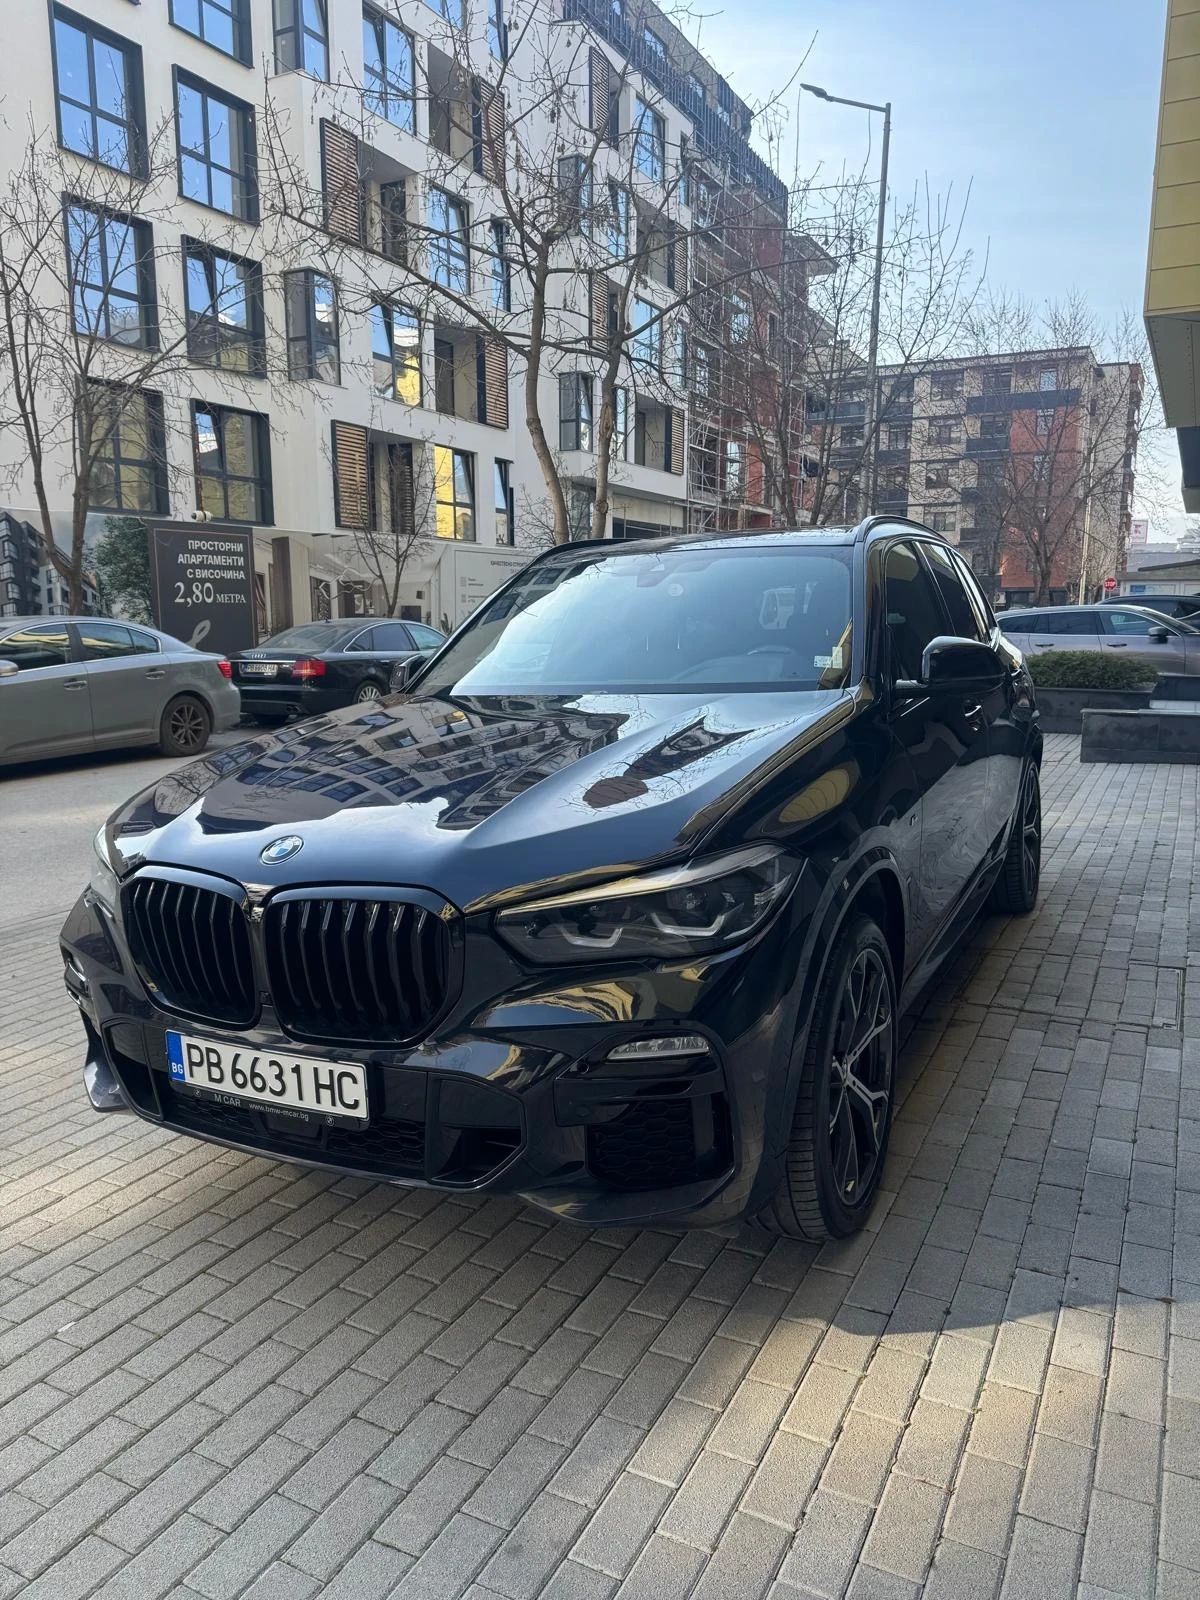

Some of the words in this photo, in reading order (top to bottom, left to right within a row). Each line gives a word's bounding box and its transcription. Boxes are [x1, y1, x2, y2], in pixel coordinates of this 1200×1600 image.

[188, 540, 243, 552] ПРОСТОРНИ
[177, 554, 244, 566] АПАРТАМЕНТИ
[186, 569, 194, 578] С
[195, 569, 246, 580] ВИСОЧИНА
[174, 581, 214, 607] 2,80
[216, 593, 246, 603] МЕТРА
[171, 1062, 184, 1075] BG
[186, 1042, 224, 1084] PB
[230, 1053, 304, 1101] 6631
[313, 1066, 360, 1110] HC
[214, 1093, 222, 1102] M
[223, 1096, 241, 1107] CAR
[249, 1102, 309, 1121] www.bmw-mcar.bg
